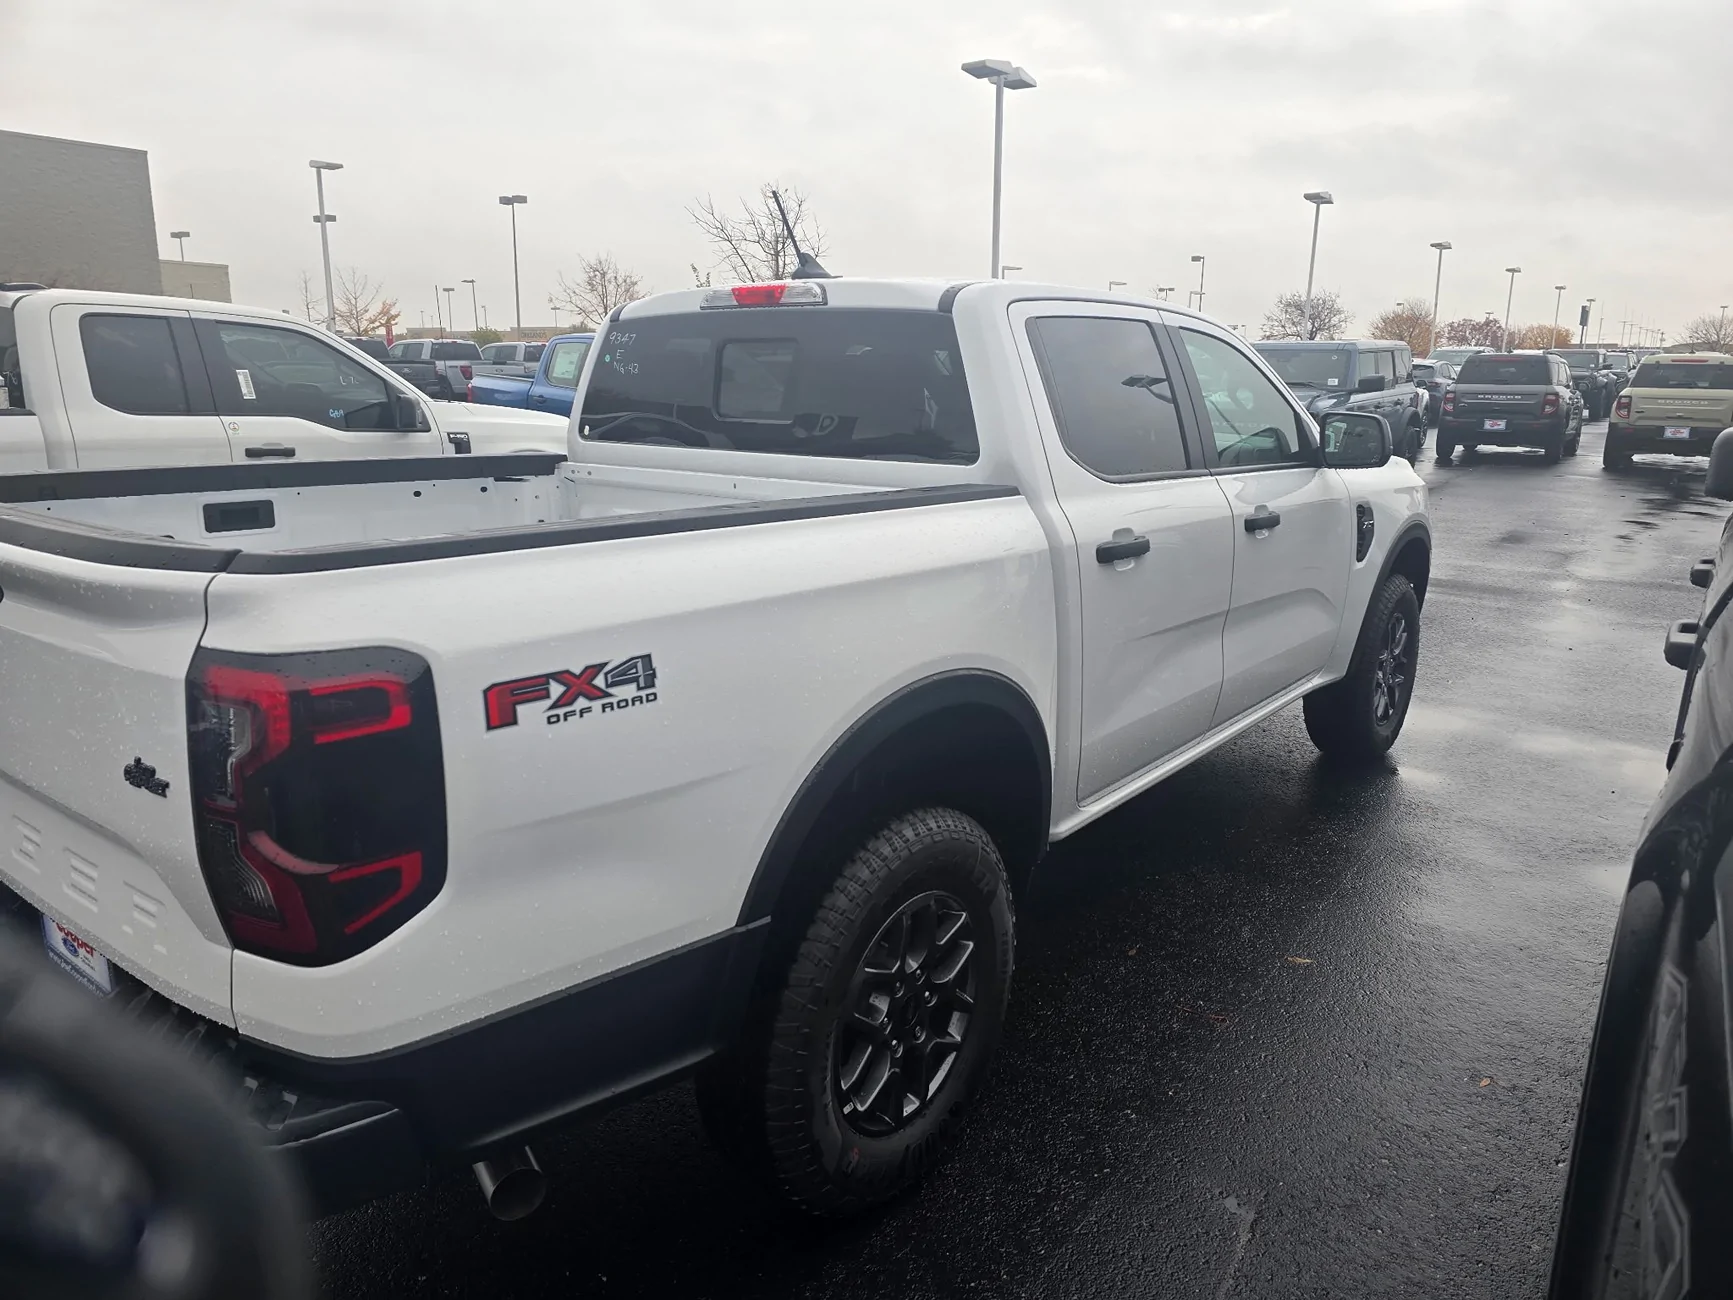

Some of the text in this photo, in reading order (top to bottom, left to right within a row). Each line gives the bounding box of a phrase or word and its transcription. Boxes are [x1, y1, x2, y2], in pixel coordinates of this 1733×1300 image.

[609, 331, 636, 346] 9347
[616, 349, 625, 359] E
[483, 652, 658, 732] FX4
[546, 692, 658, 725] OFF ROAD
